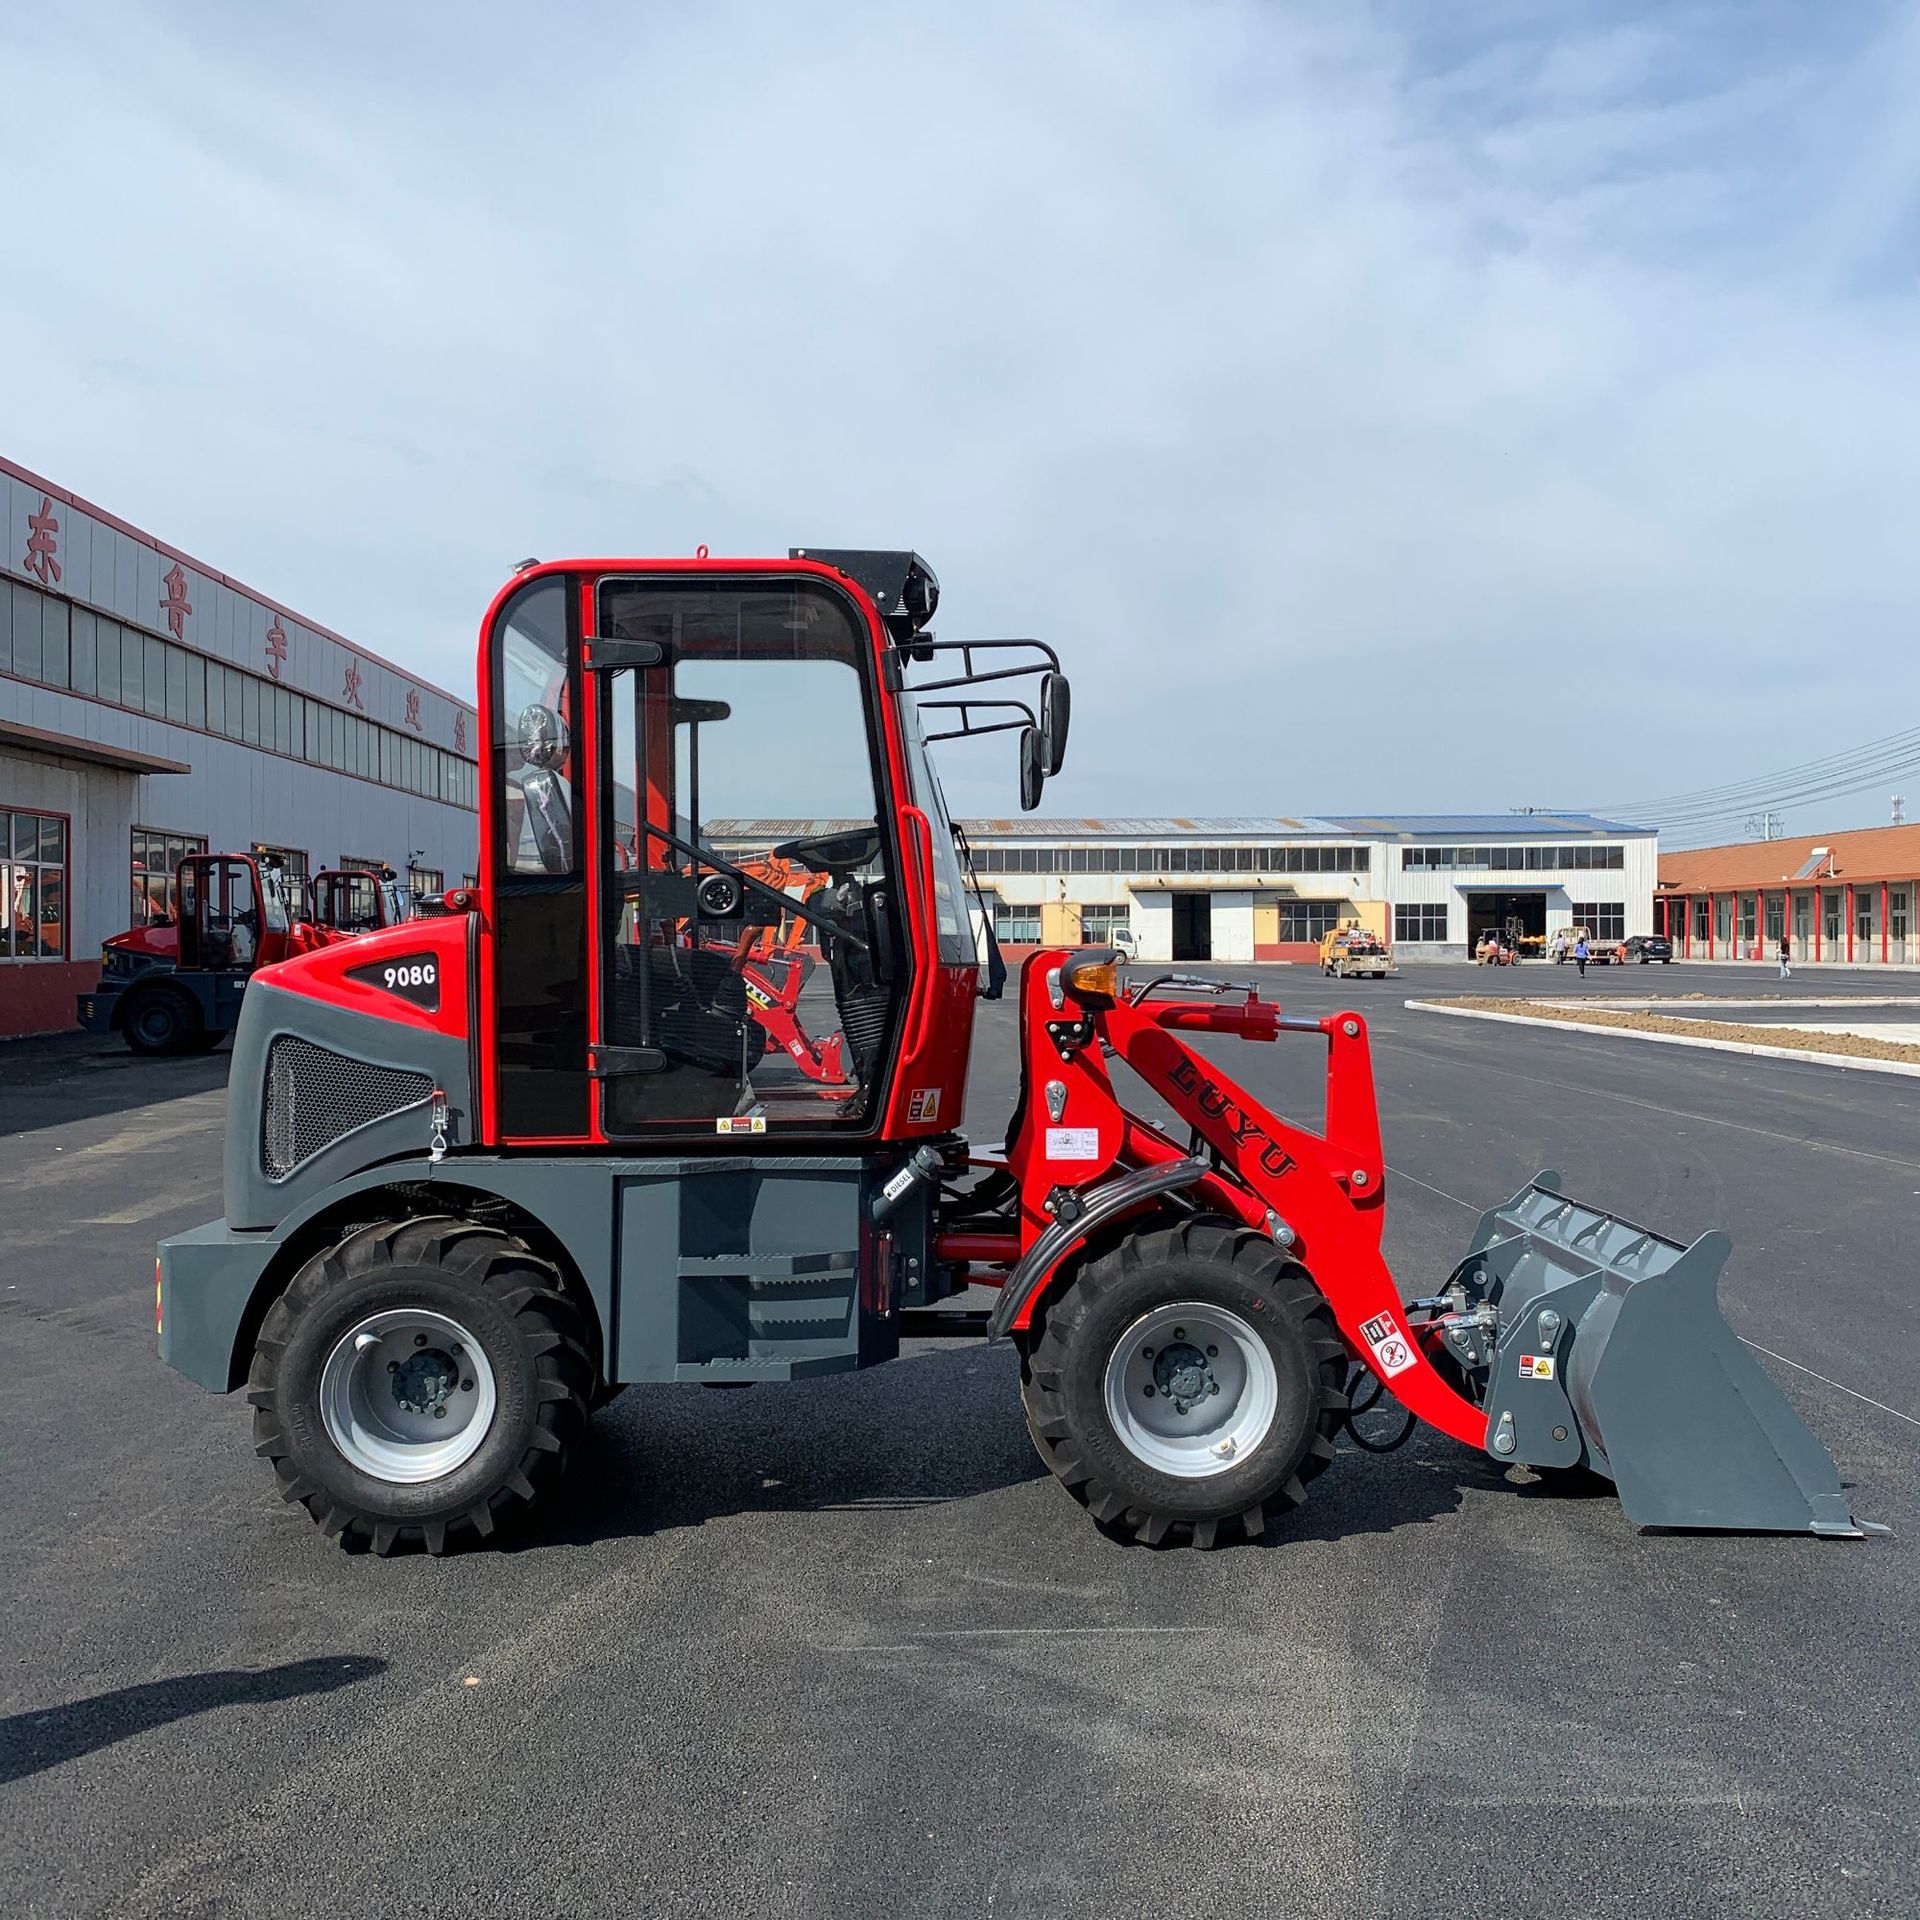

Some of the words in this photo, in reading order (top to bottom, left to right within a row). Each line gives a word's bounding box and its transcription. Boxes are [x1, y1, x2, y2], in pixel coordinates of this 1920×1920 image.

[384, 964, 436, 988] 908C
[1168, 1054, 1298, 1178] LUYU
[890, 1173, 911, 1193] DIESEL
